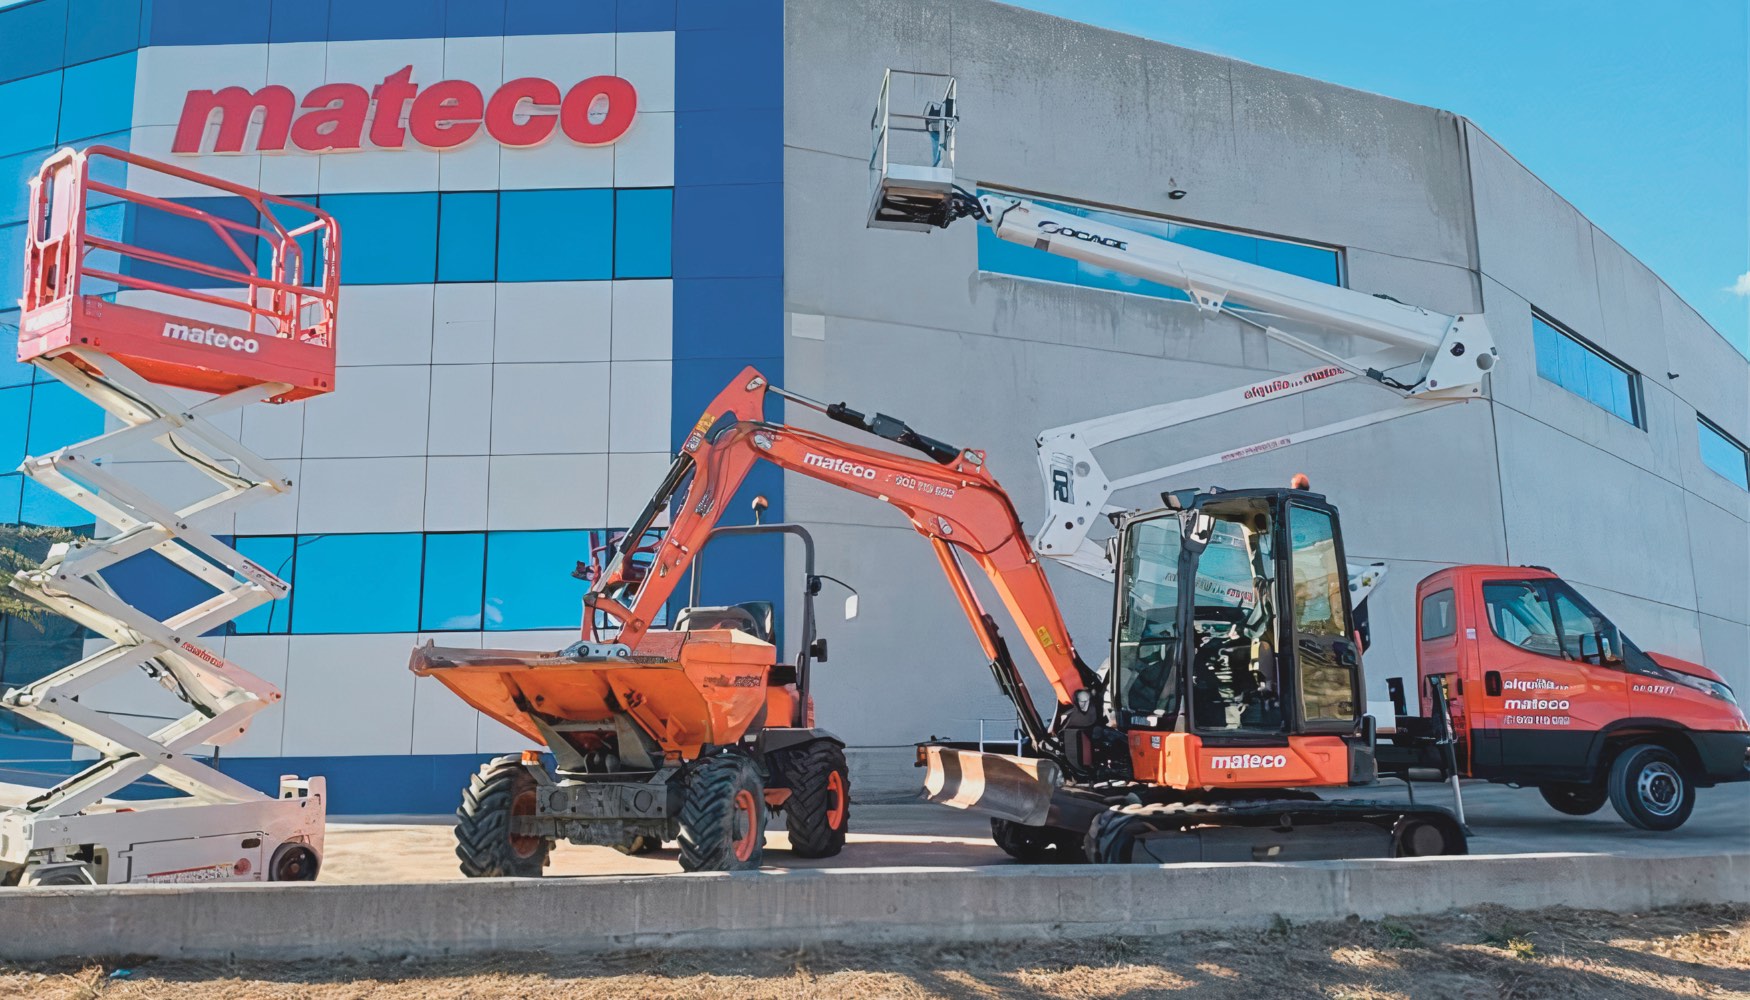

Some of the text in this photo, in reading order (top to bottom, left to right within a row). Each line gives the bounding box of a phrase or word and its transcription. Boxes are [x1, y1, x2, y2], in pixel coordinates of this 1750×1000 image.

[171, 64, 638, 153] mateco
[162, 322, 259, 353] mateco
[803, 452, 876, 480] mateco
[1504, 699, 1569, 710] mateco
[1211, 753, 1287, 769] mateco
